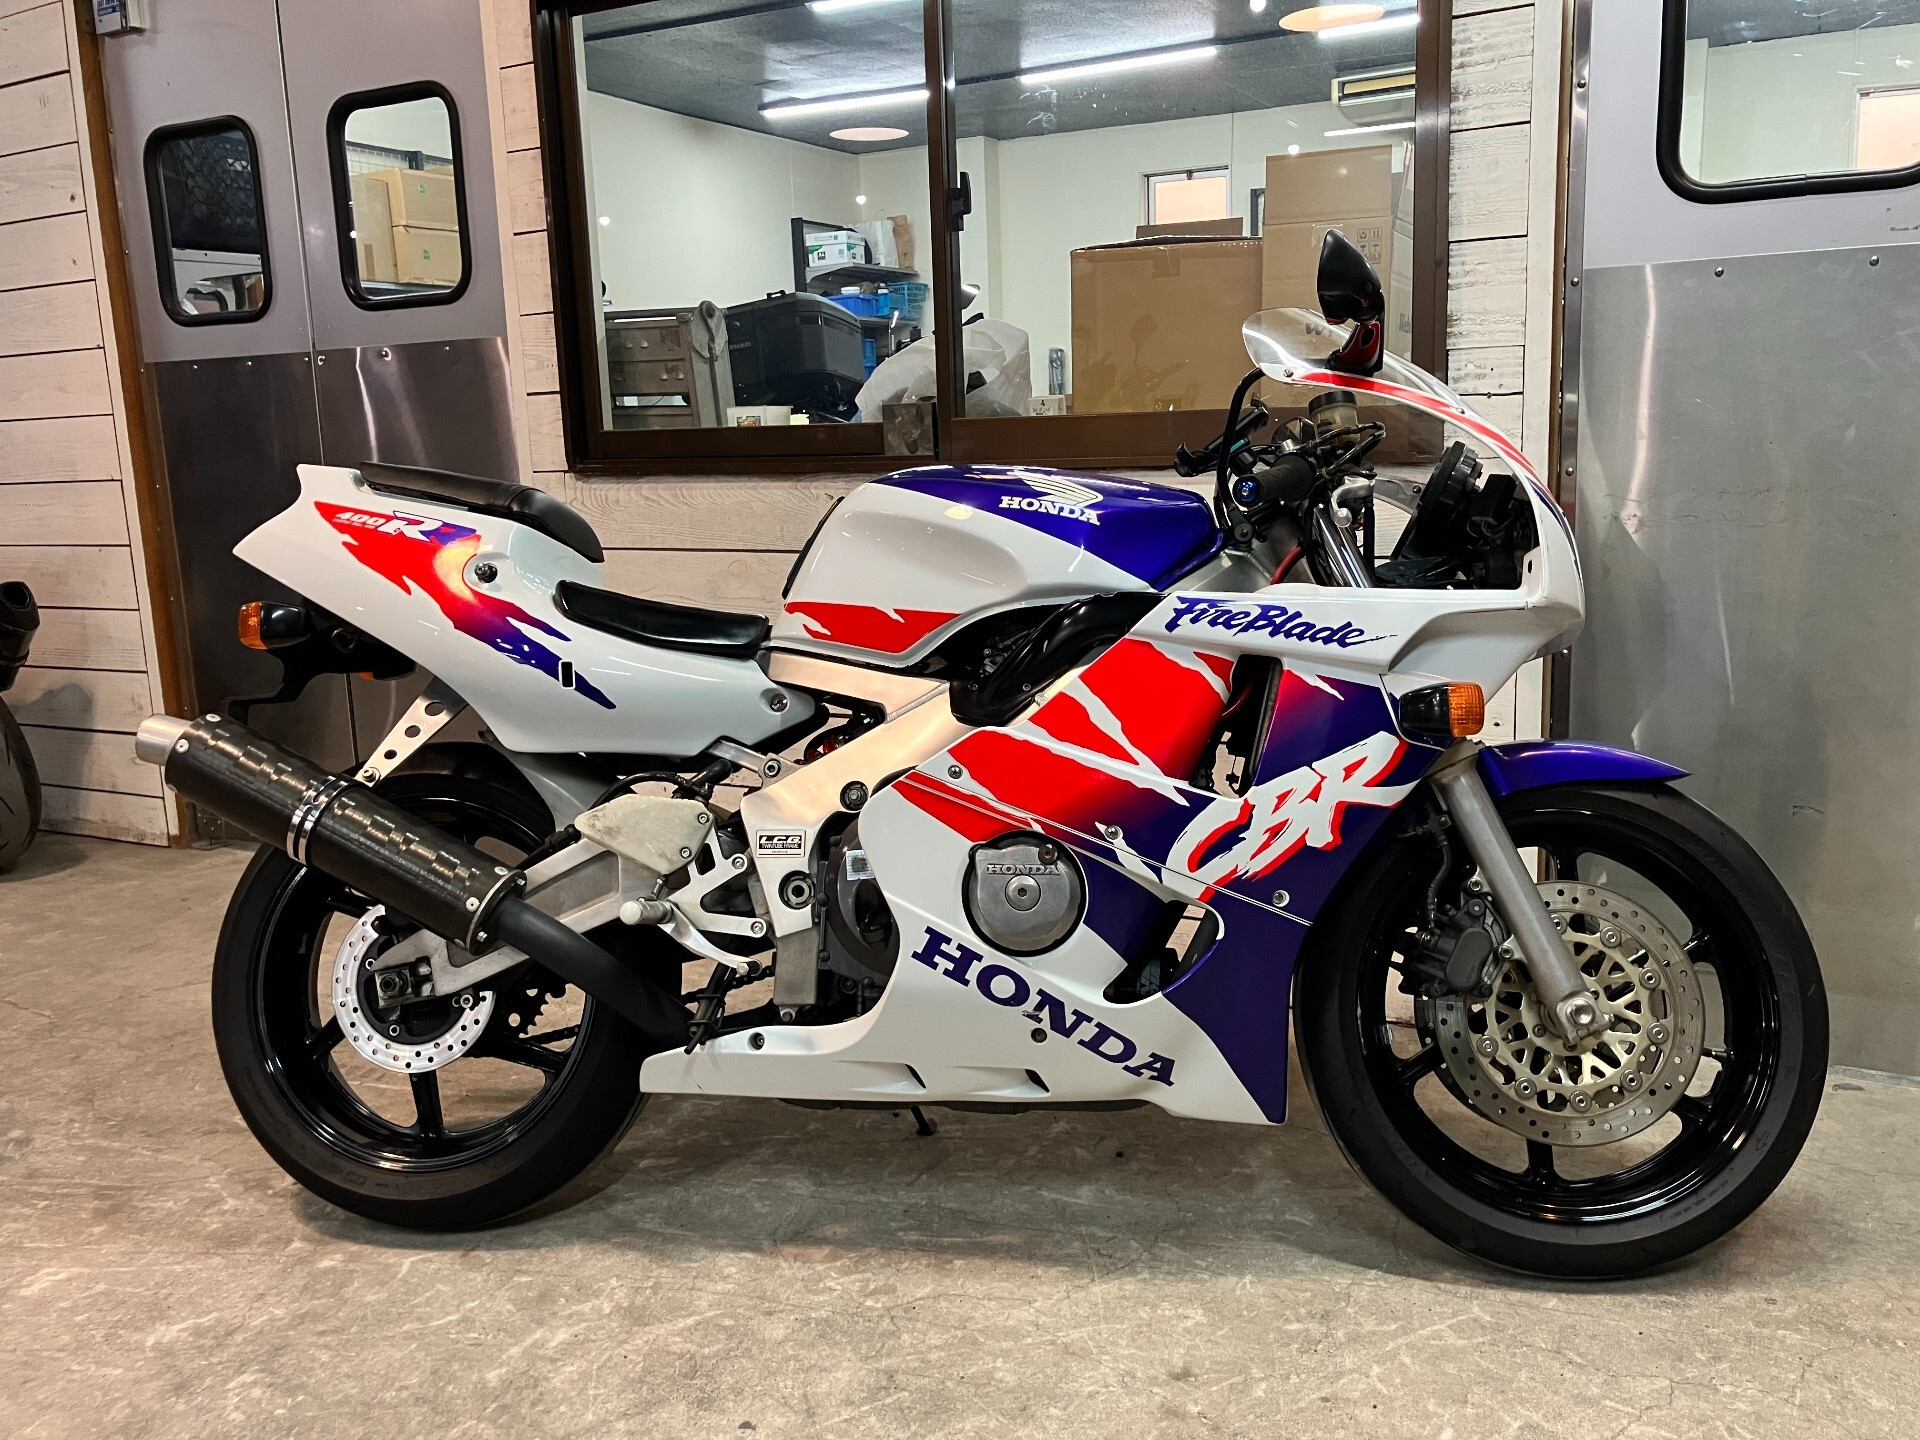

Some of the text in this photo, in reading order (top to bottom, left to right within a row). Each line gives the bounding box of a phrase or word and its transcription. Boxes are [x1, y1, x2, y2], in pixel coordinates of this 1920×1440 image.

[999, 496, 1101, 526] HONDA
[1165, 596, 1397, 648] FireBlade
[1161, 730, 1422, 903] CBR
[987, 863, 1061, 876] HONDA
[911, 925, 1176, 1088] HONDA
